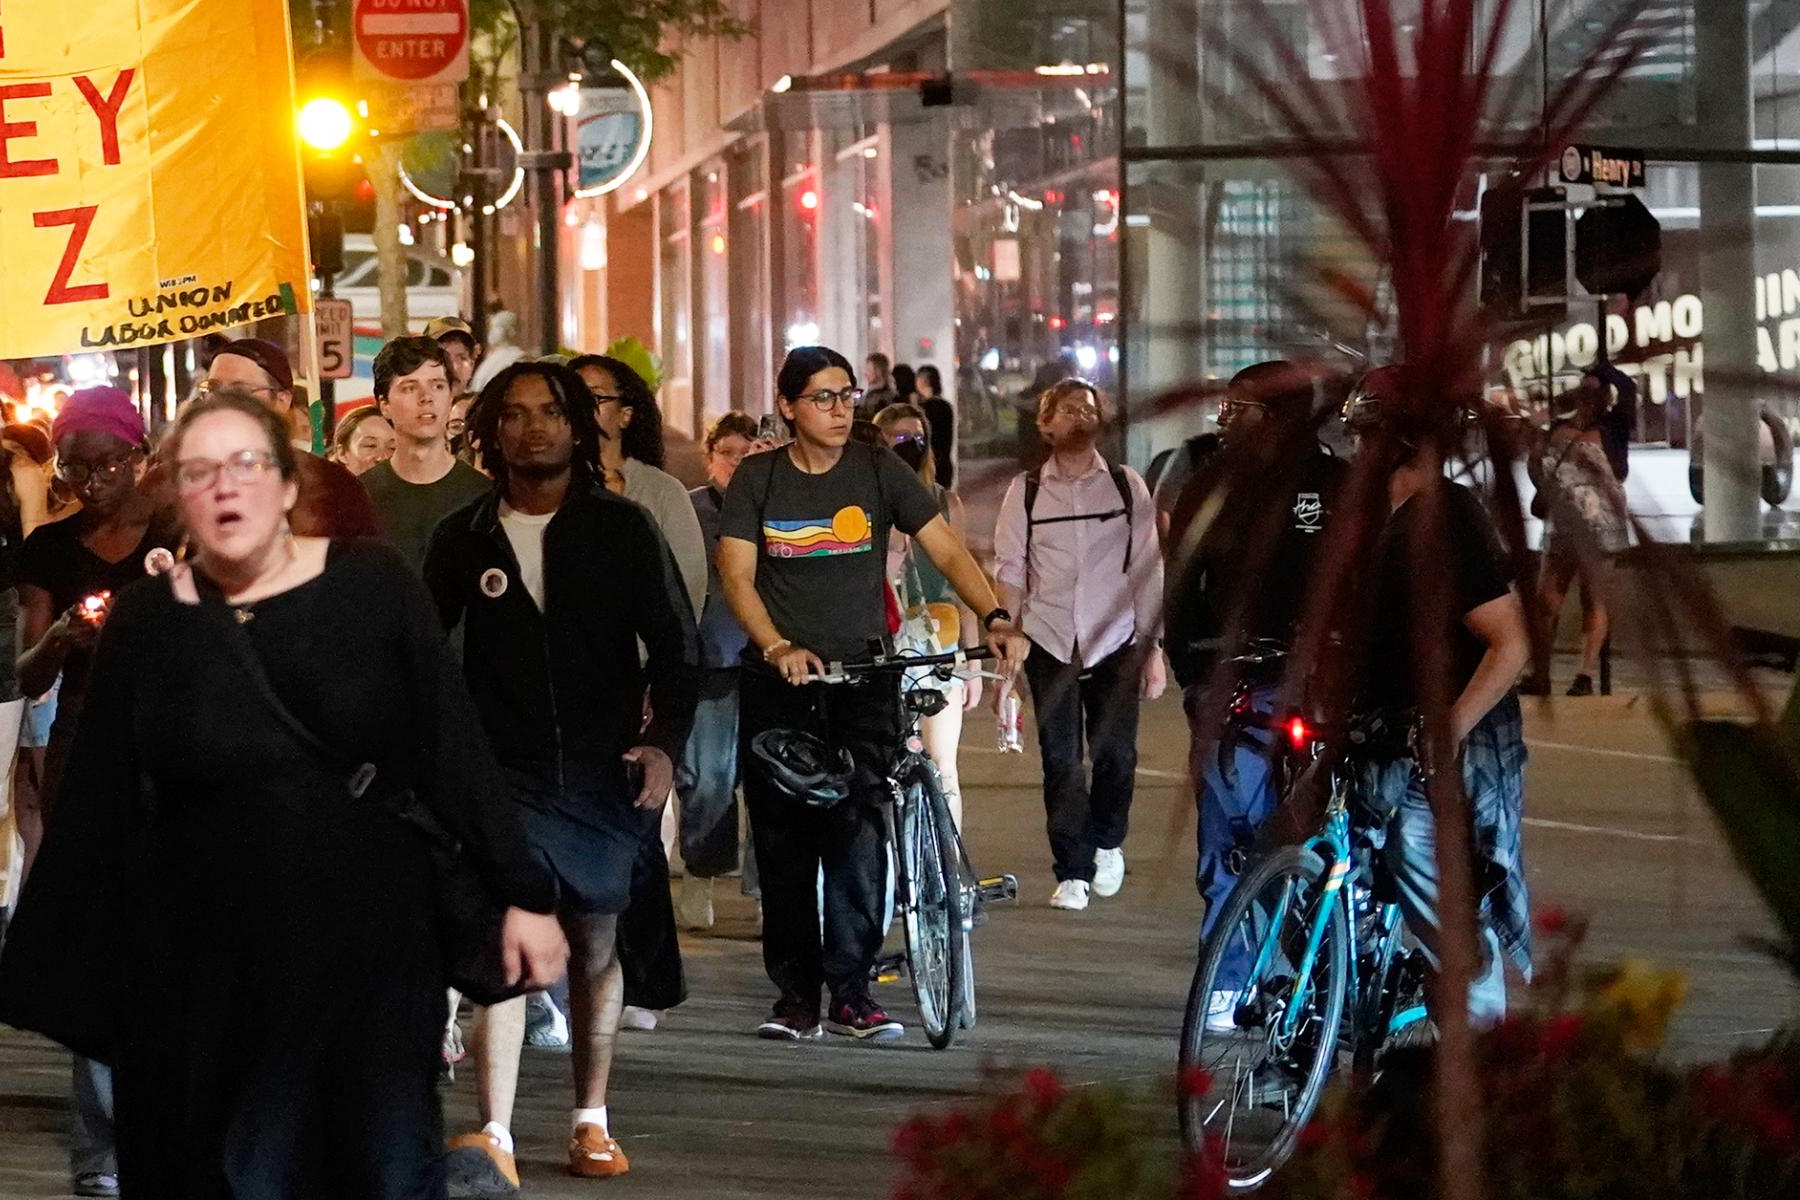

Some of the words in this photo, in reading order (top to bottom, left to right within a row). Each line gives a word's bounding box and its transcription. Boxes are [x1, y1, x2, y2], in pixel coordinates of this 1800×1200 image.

[375, 38, 446, 59] ENTER
[1592, 150, 1630, 189] Henry
[127, 281, 232, 318] UNION
[80, 319, 175, 348] LABOR
[179, 295, 284, 334] DONATED
[323, 340, 344, 372] 5
